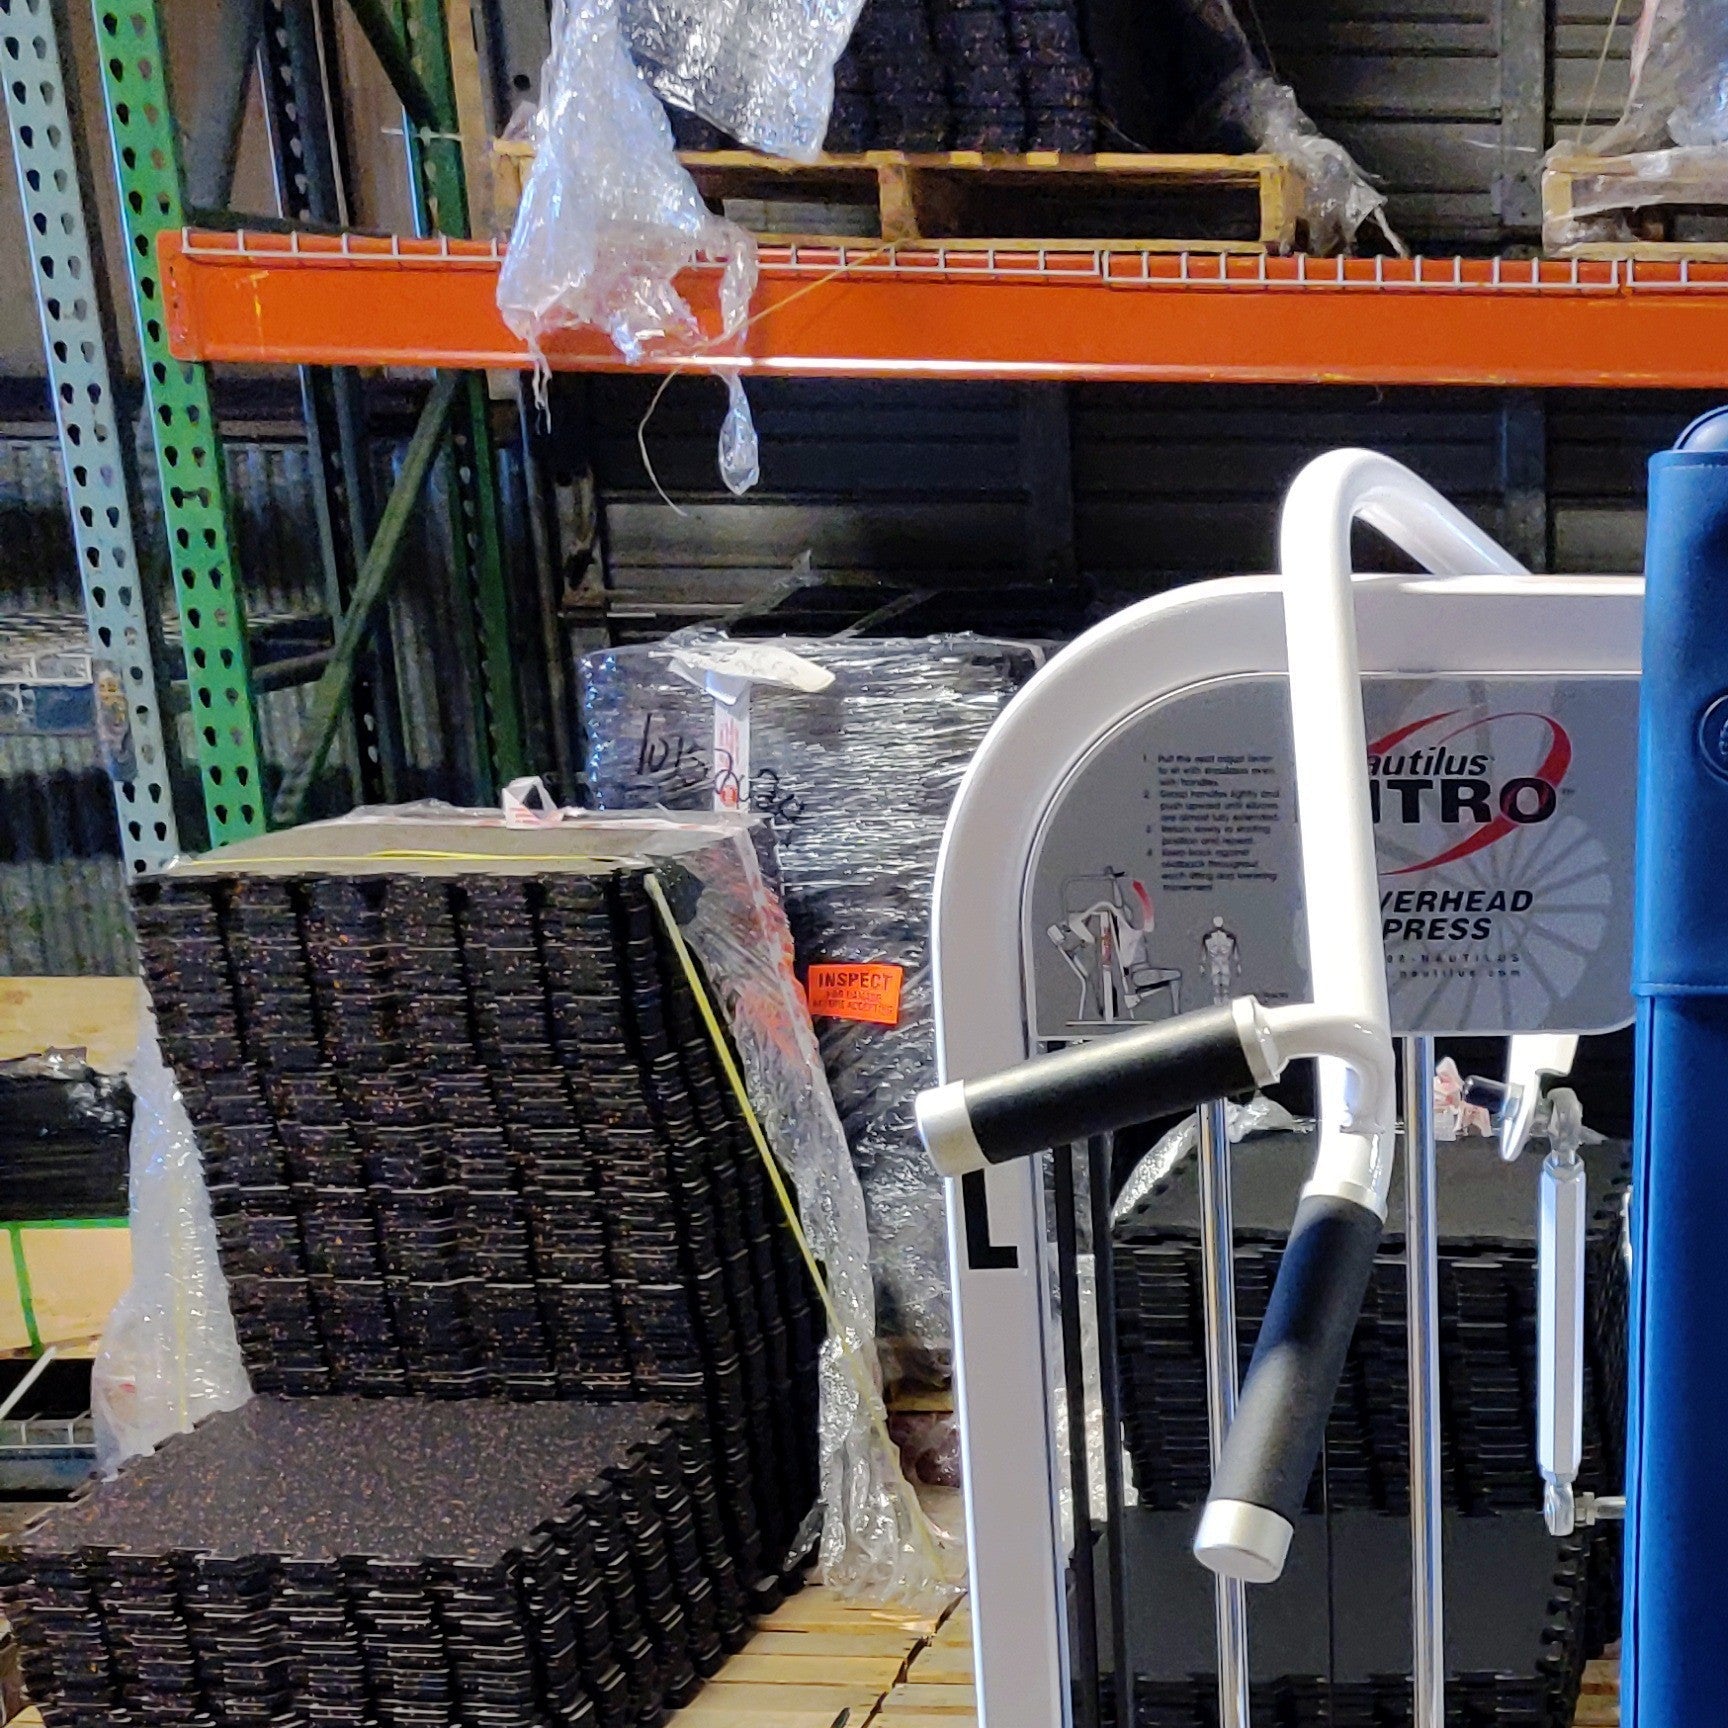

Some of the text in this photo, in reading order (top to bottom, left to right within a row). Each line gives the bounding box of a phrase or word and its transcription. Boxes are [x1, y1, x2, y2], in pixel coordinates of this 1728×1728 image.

[1367, 747, 1489, 776] autilus
[1369, 777, 1557, 824] ITRO
[1380, 889, 1534, 913] VERHEAD
[1383, 917, 1492, 940] PRESS
[818, 972, 893, 991] INSPECT
